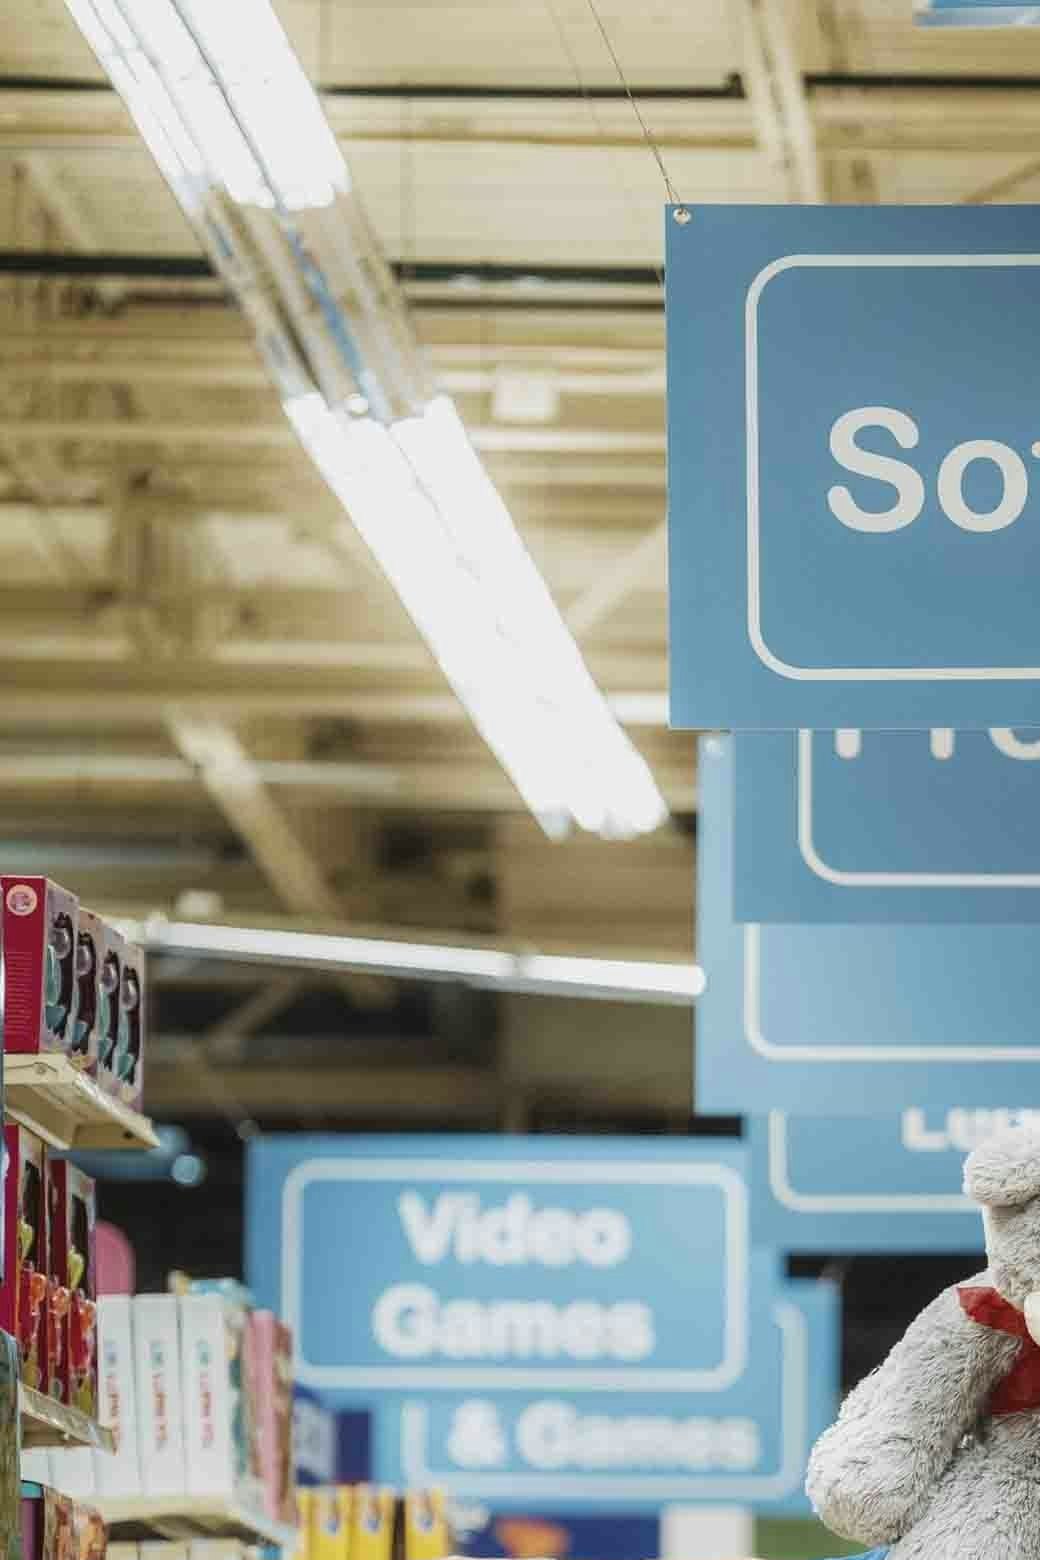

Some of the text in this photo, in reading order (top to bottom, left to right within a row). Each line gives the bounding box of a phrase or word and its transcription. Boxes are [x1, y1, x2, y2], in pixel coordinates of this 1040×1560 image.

[399, 1193, 631, 1268] Video
[372, 1283, 656, 1360] Games
[446, 1400, 760, 1470] & Games
